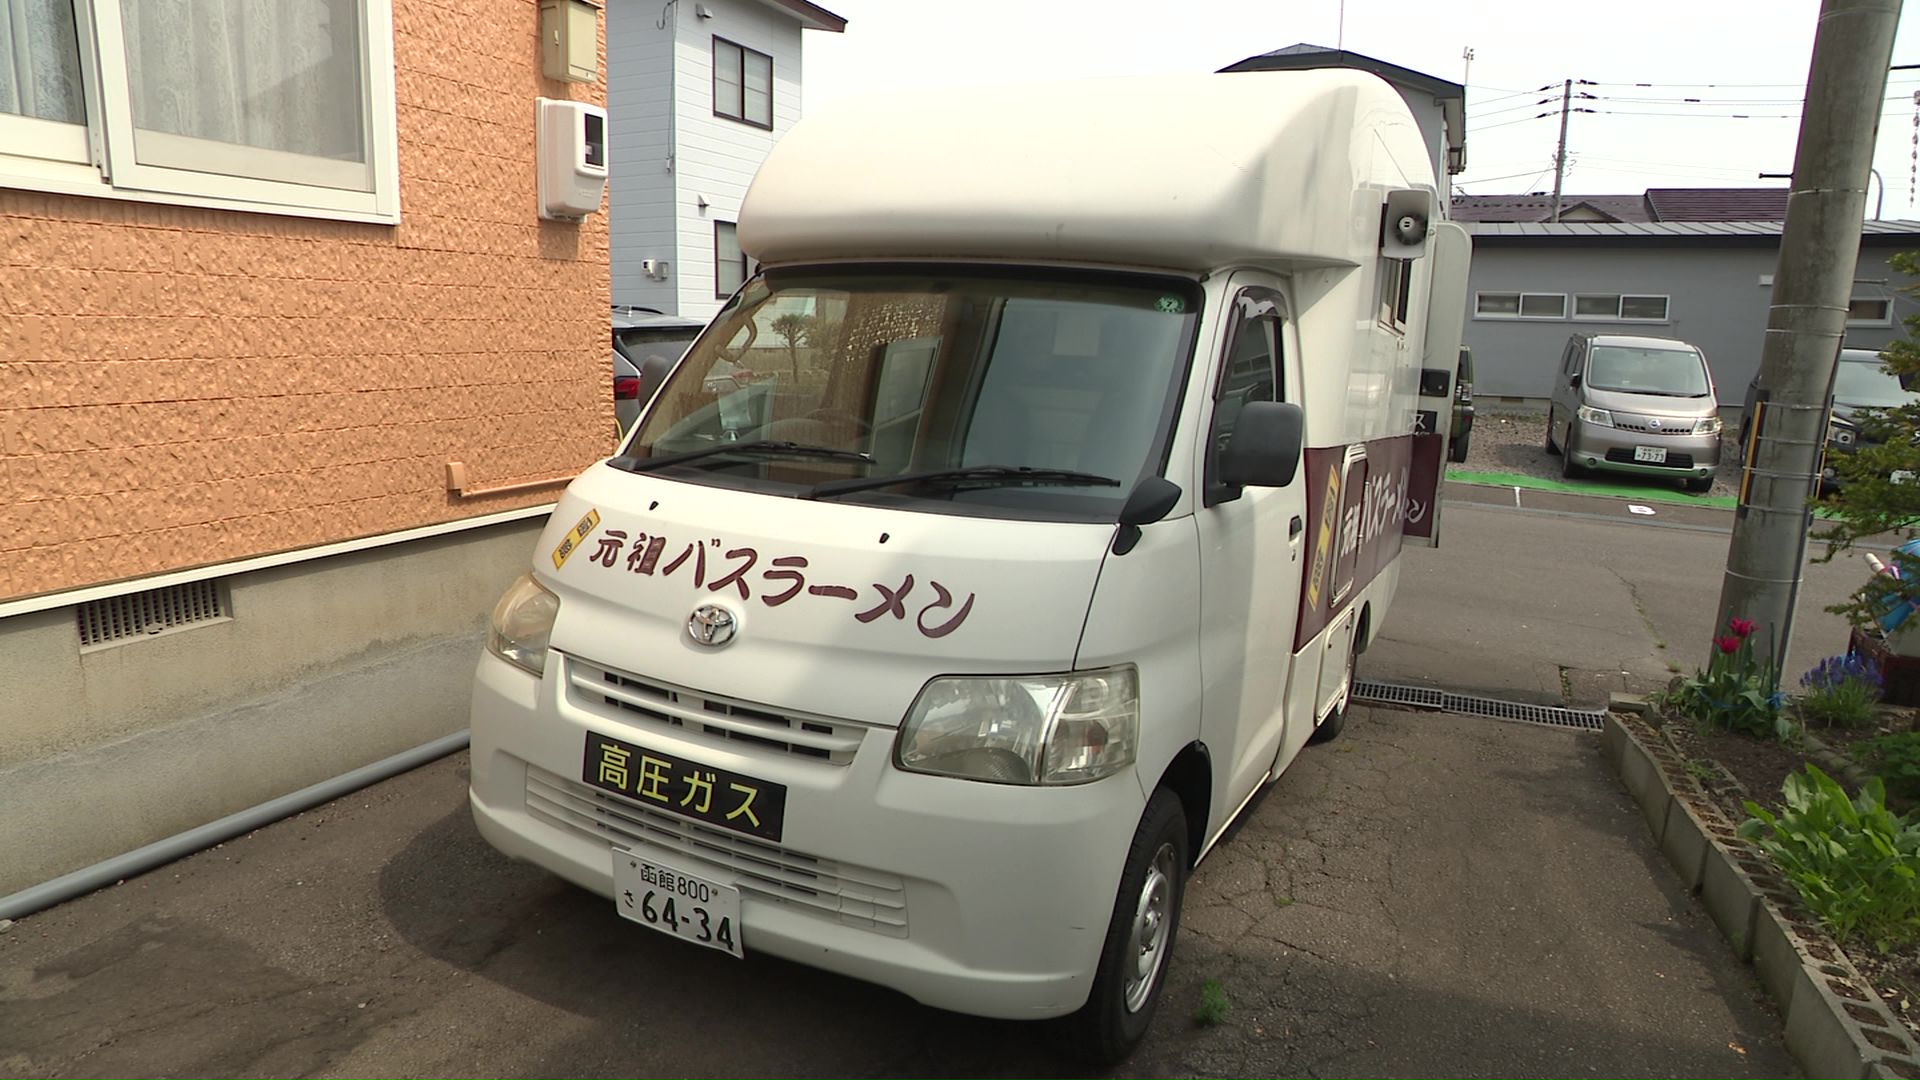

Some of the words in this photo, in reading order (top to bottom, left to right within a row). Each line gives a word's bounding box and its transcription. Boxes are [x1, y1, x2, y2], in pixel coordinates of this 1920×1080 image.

[589, 530, 976, 638] 元祖バスラーメン
[599, 743, 761, 828] 高圧ガス
[623, 889, 635, 909] さ
[641, 889, 734, 952] 64-34
